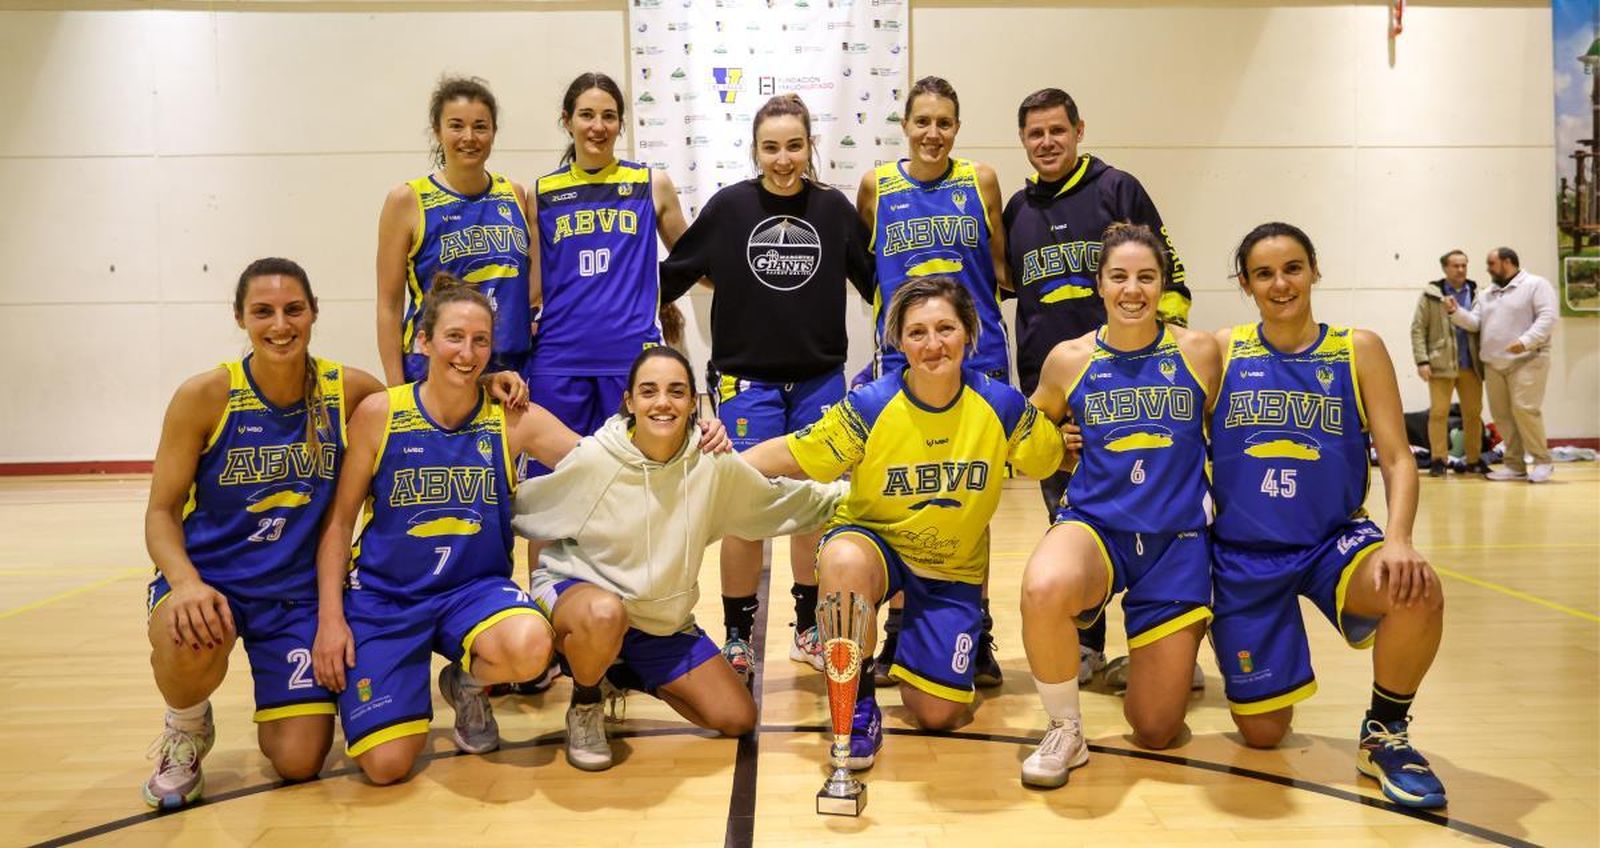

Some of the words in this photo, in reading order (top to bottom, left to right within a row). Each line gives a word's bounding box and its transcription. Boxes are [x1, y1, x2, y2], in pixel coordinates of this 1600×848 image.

[440, 225, 528, 264] ABVO
[553, 208, 637, 244] ABVO
[883, 215, 979, 257] ABVO
[579, 248, 610, 277] 00
[752, 254, 814, 272] GIANTS
[1022, 241, 1104, 286] ABVO
[1085, 386, 1192, 425] ABVO
[1224, 390, 1344, 436] ABVO
[219, 442, 337, 485] ABVO
[882, 460, 989, 496] ABVO
[1130, 459, 1146, 485] 6
[1260, 468, 1297, 498] 45
[389, 466, 499, 507] ABVO
[247, 517, 287, 542] 23
[432, 546, 452, 576] 7
[286, 648, 313, 690] 2
[951, 632, 973, 674] 8
